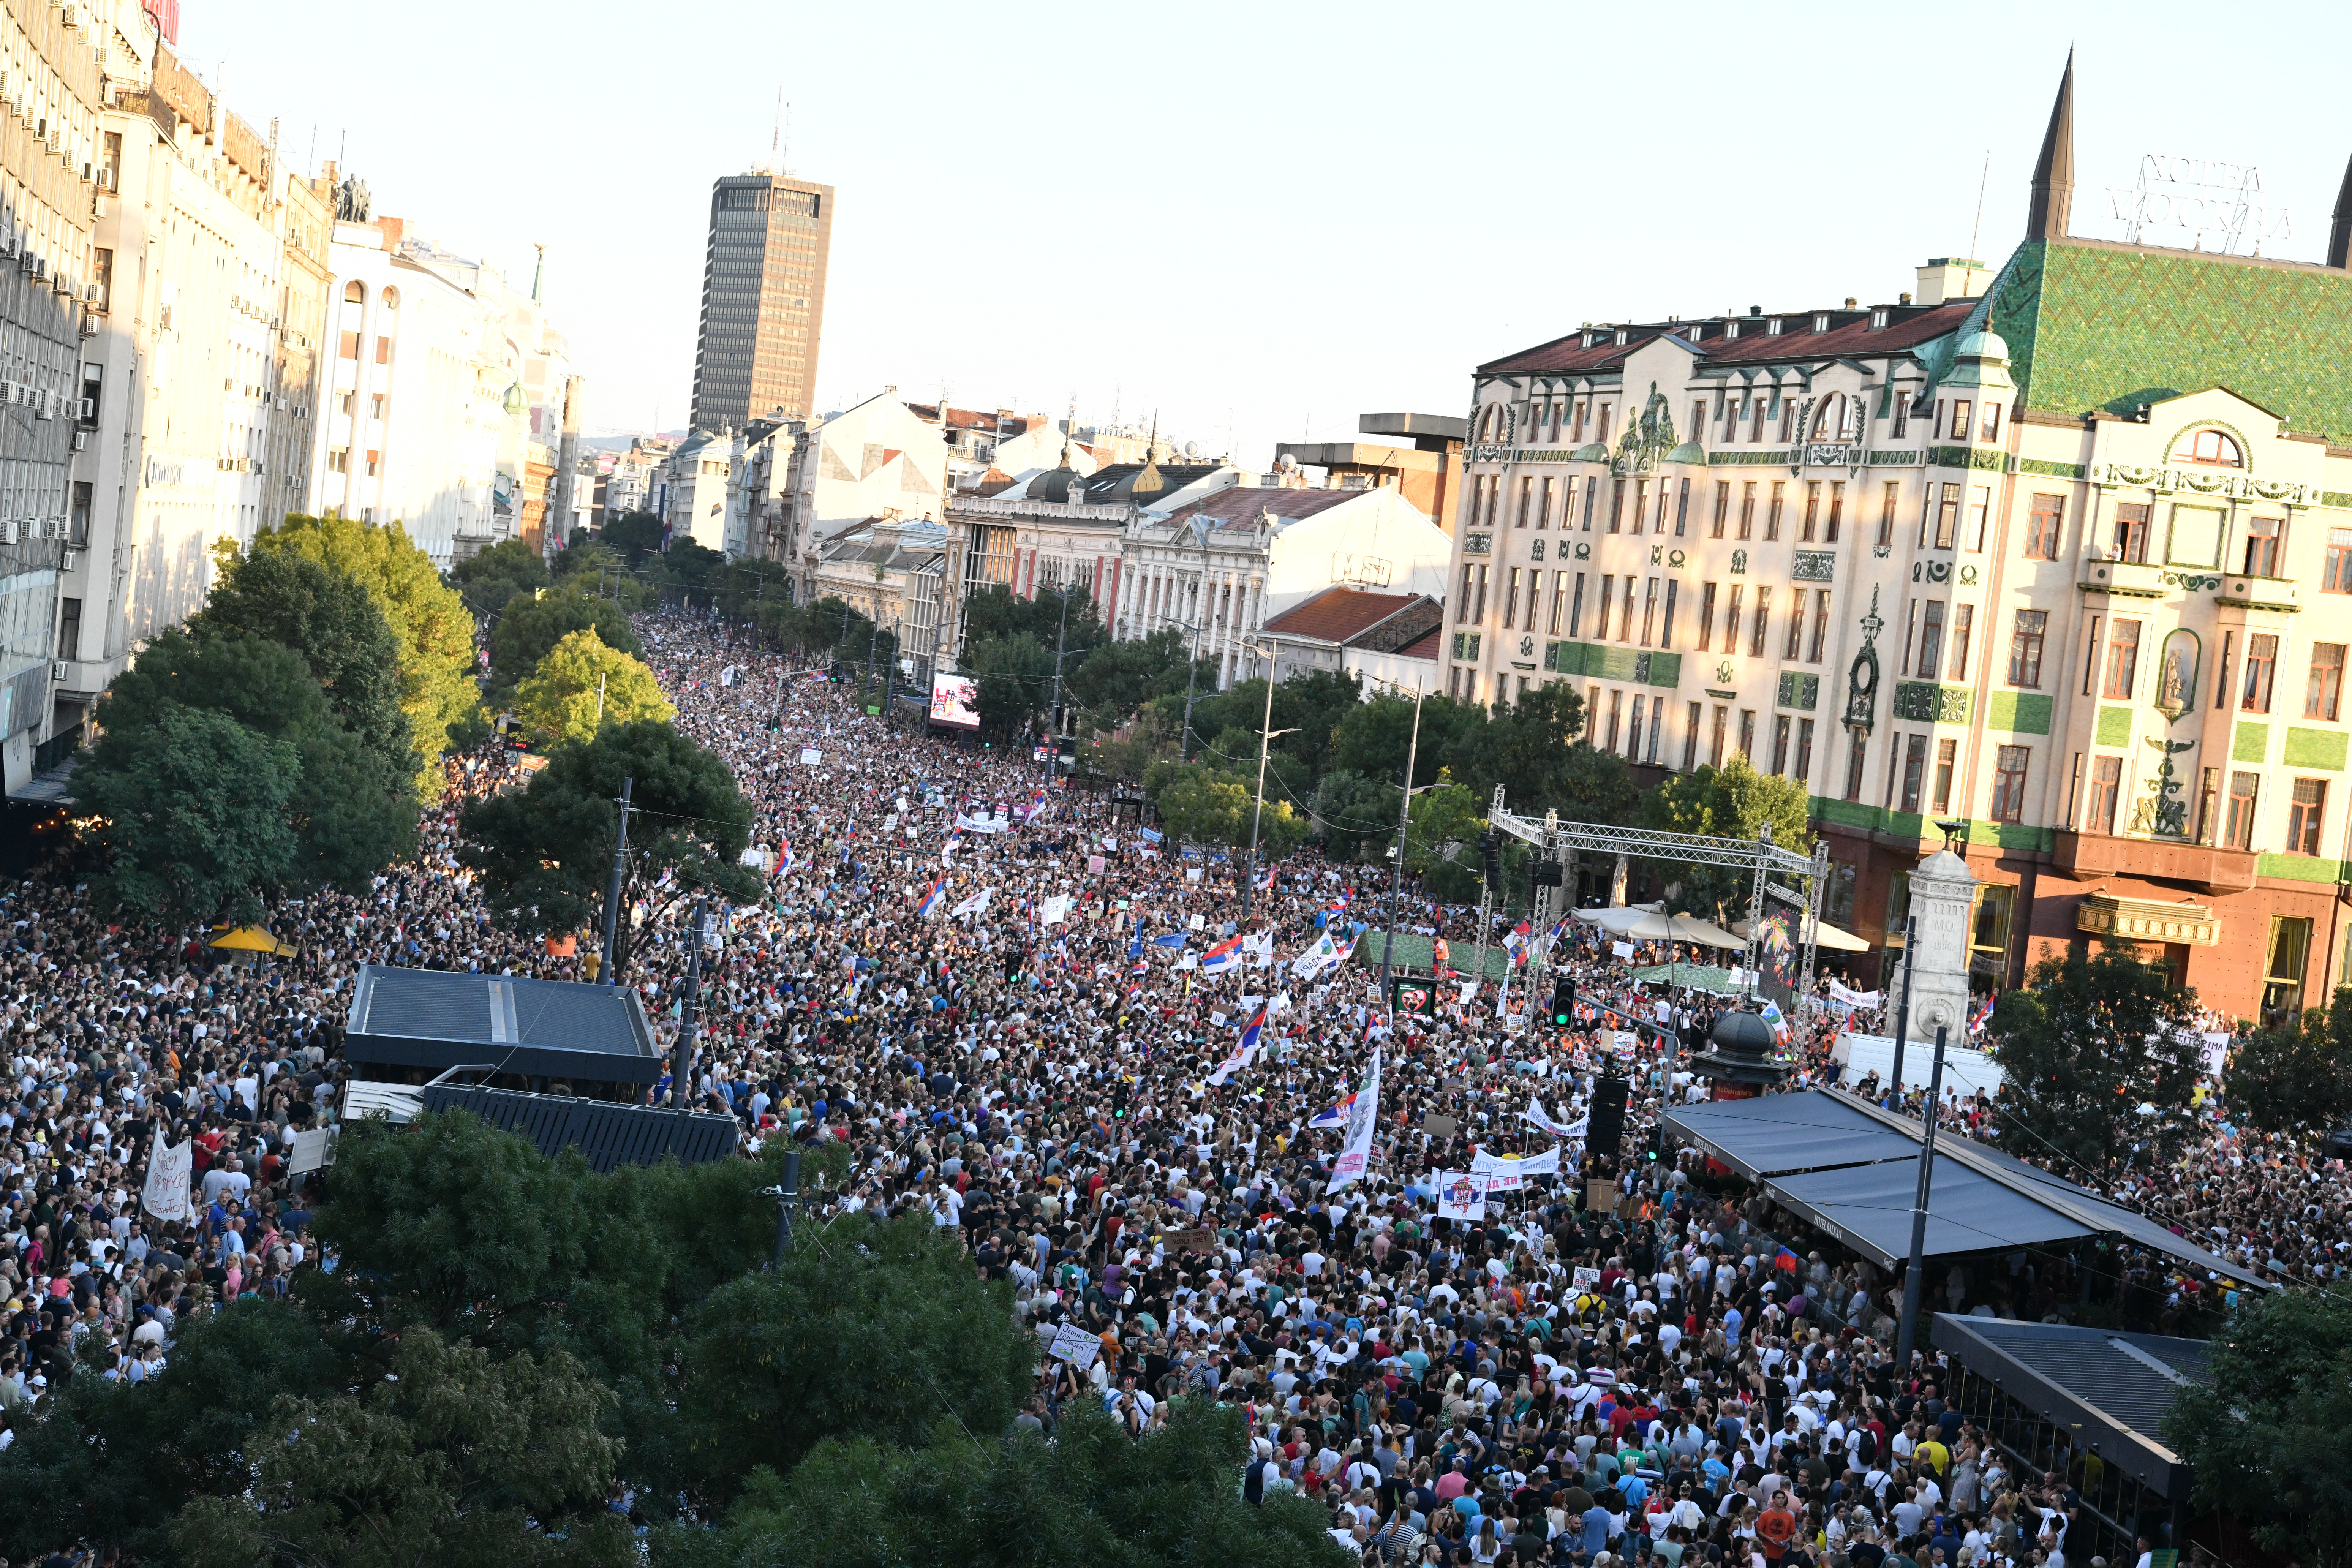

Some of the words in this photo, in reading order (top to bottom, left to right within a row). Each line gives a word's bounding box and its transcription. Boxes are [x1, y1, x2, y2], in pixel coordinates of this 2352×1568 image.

[2147, 154, 2265, 193] ХОТЕЛ
[2102, 188, 2297, 240] МОСКВА
[1716, 1085, 1752, 1097] McDonald's
[1693, 1136, 1704, 1150] HOTEL
[1703, 1141, 1717, 1157] BALKAN
[1813, 1214, 1826, 1230] HOTEL
[1825, 1221, 1842, 1239] BALKAN
[1192, 1235, 1208, 1244] STE!
[1532, 1236, 1543, 1246] НЕЋЕТЕ
[1576, 1269, 1598, 1277] НЕЋЕТЕ
[1062, 1324, 1082, 1339] JEDINI
[1083, 1332, 1099, 1344] RIO
[1624, 1456, 1640, 1466] JUST
